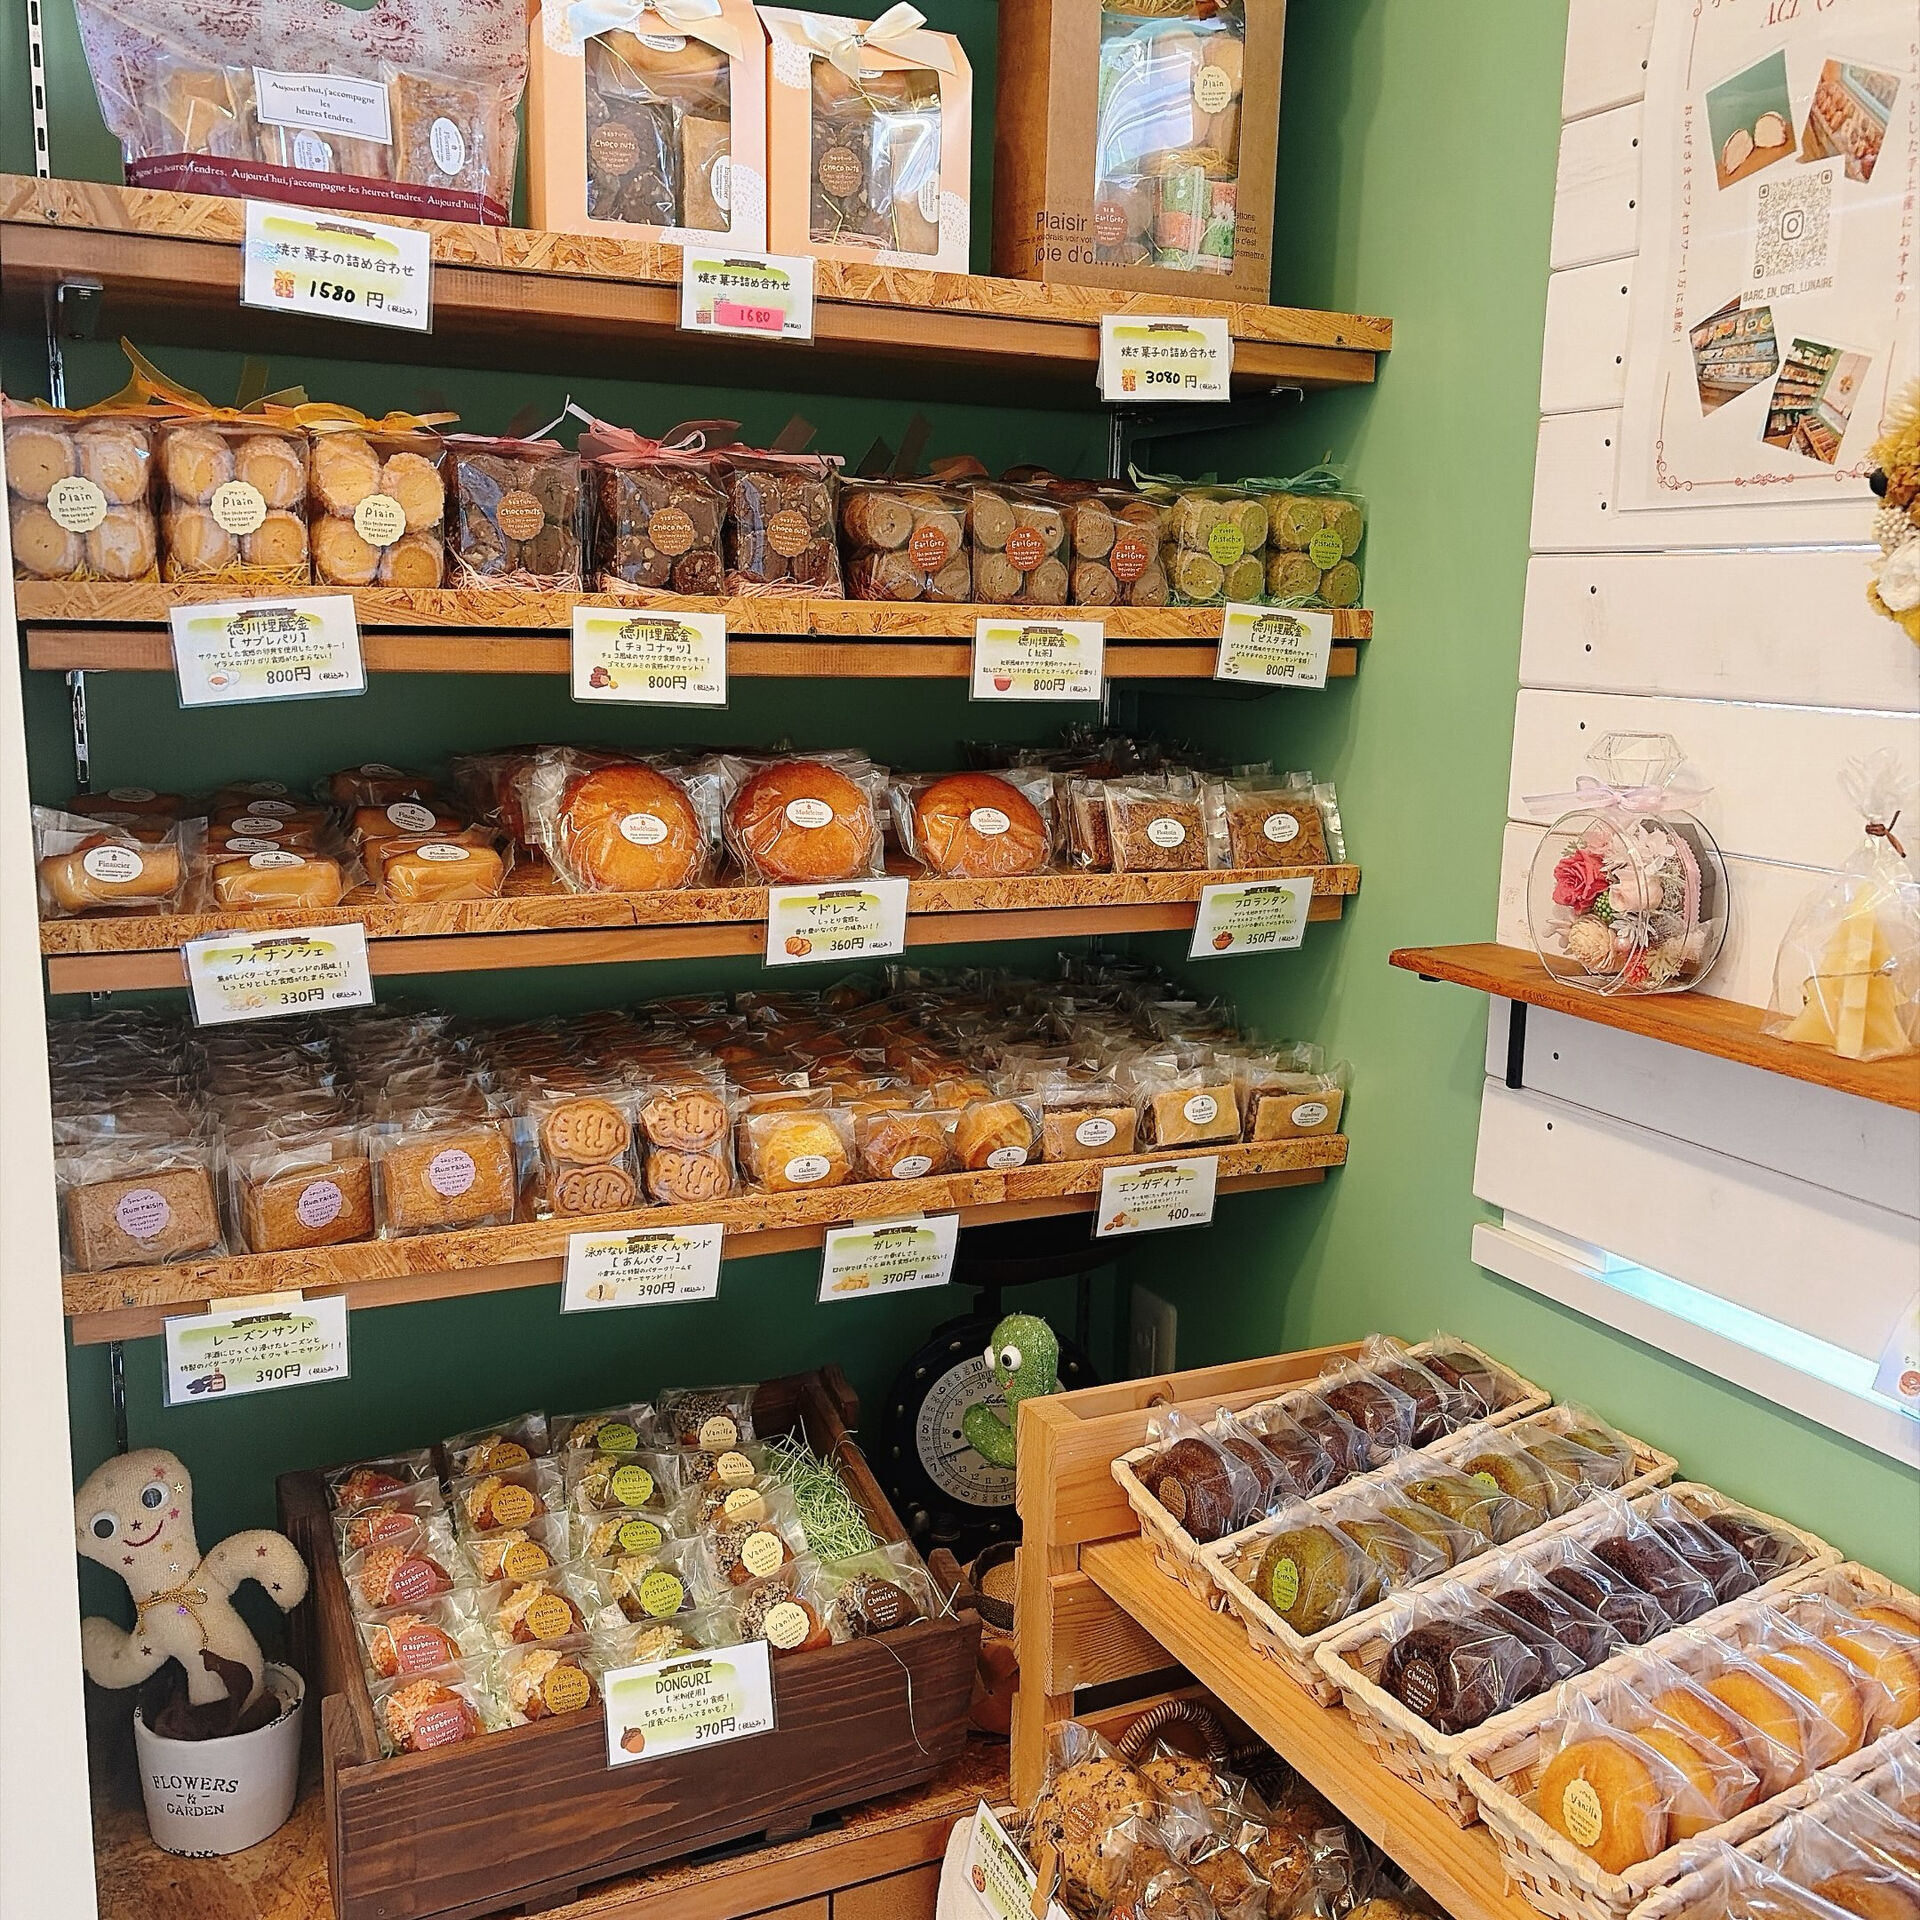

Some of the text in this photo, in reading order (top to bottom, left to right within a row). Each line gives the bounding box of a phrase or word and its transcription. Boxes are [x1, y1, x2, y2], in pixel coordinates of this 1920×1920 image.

[348, 184, 360, 195] les
[361, 186, 390, 199] heures
[1035, 211, 1088, 232] Plaisir
[698, 272, 791, 292] 焼き菓子詰め合わせ
[310, 280, 356, 304] 1580
[366, 291, 385, 309] 円
[740, 309, 771, 324] 1680
[1120, 345, 1217, 360] 焼き菓子の詰め合わせ
[1145, 370, 1181, 385] 3080
[1184, 375, 1198, 389] 円
[59, 492, 93, 504] Plain
[222, 496, 254, 508] Plain
[365, 507, 395, 518] Plain
[652, 523, 675, 532] Choco
[771, 524, 793, 534] Choco
[914, 541, 929, 549] Earl
[1012, 540, 1026, 548] Earl
[1116, 551, 1130, 560] Earl
[226, 616, 311, 636] 徳川埋蔵金
[619, 626, 692, 643] 徳川埋蔵金
[266, 665, 312, 684] 800円
[1265, 664, 1296, 678] 800円
[648, 675, 688, 690] 800円
[1033, 678, 1066, 692] 800円
[807, 901, 868, 916] マドレーヌ
[1235, 895, 1289, 909] フロランタン
[830, 936, 865, 951] 360円
[1246, 930, 1277, 945] 350円
[232, 947, 325, 966] フィナンシェ
[280, 987, 325, 1005] 330円
[434, 1162, 472, 1174] Rum raisin
[1119, 1176, 1194, 1193] エンガディナー
[303, 1193, 340, 1208] Rum raisin
[122, 1201, 164, 1216] Rum raisin
[1167, 1207, 1189, 1221] 400
[873, 1236, 917, 1251] ガレット
[881, 1269, 918, 1285] 370円
[638, 1281, 676, 1296] 390円
[213, 1320, 314, 1347] レーズンサンド
[255, 1363, 301, 1384] 390円
[971, 1361, 983, 1372] 10
[705, 1428, 733, 1438] Vanilla
[921, 1424, 929, 1434] 8
[498, 1495, 528, 1506] Almond
[747, 1541, 775, 1558] Vanilla
[512, 1552, 541, 1565] Almond
[394, 1569, 430, 1590] Raspberry
[534, 1607, 564, 1619] Almond
[771, 1611, 800, 1632] Vanilla
[402, 1639, 440, 1652] Raspberry
[552, 1680, 582, 1693] Almond
[656, 1671, 713, 1694] DONGURI
[419, 1715, 460, 1736] Raspberry
[695, 1716, 736, 1740] 370円
[152, 1775, 239, 1793] FLOWERS
[166, 1803, 225, 1817] GARDEN
[1571, 1793, 1598, 1820] Vanilla
